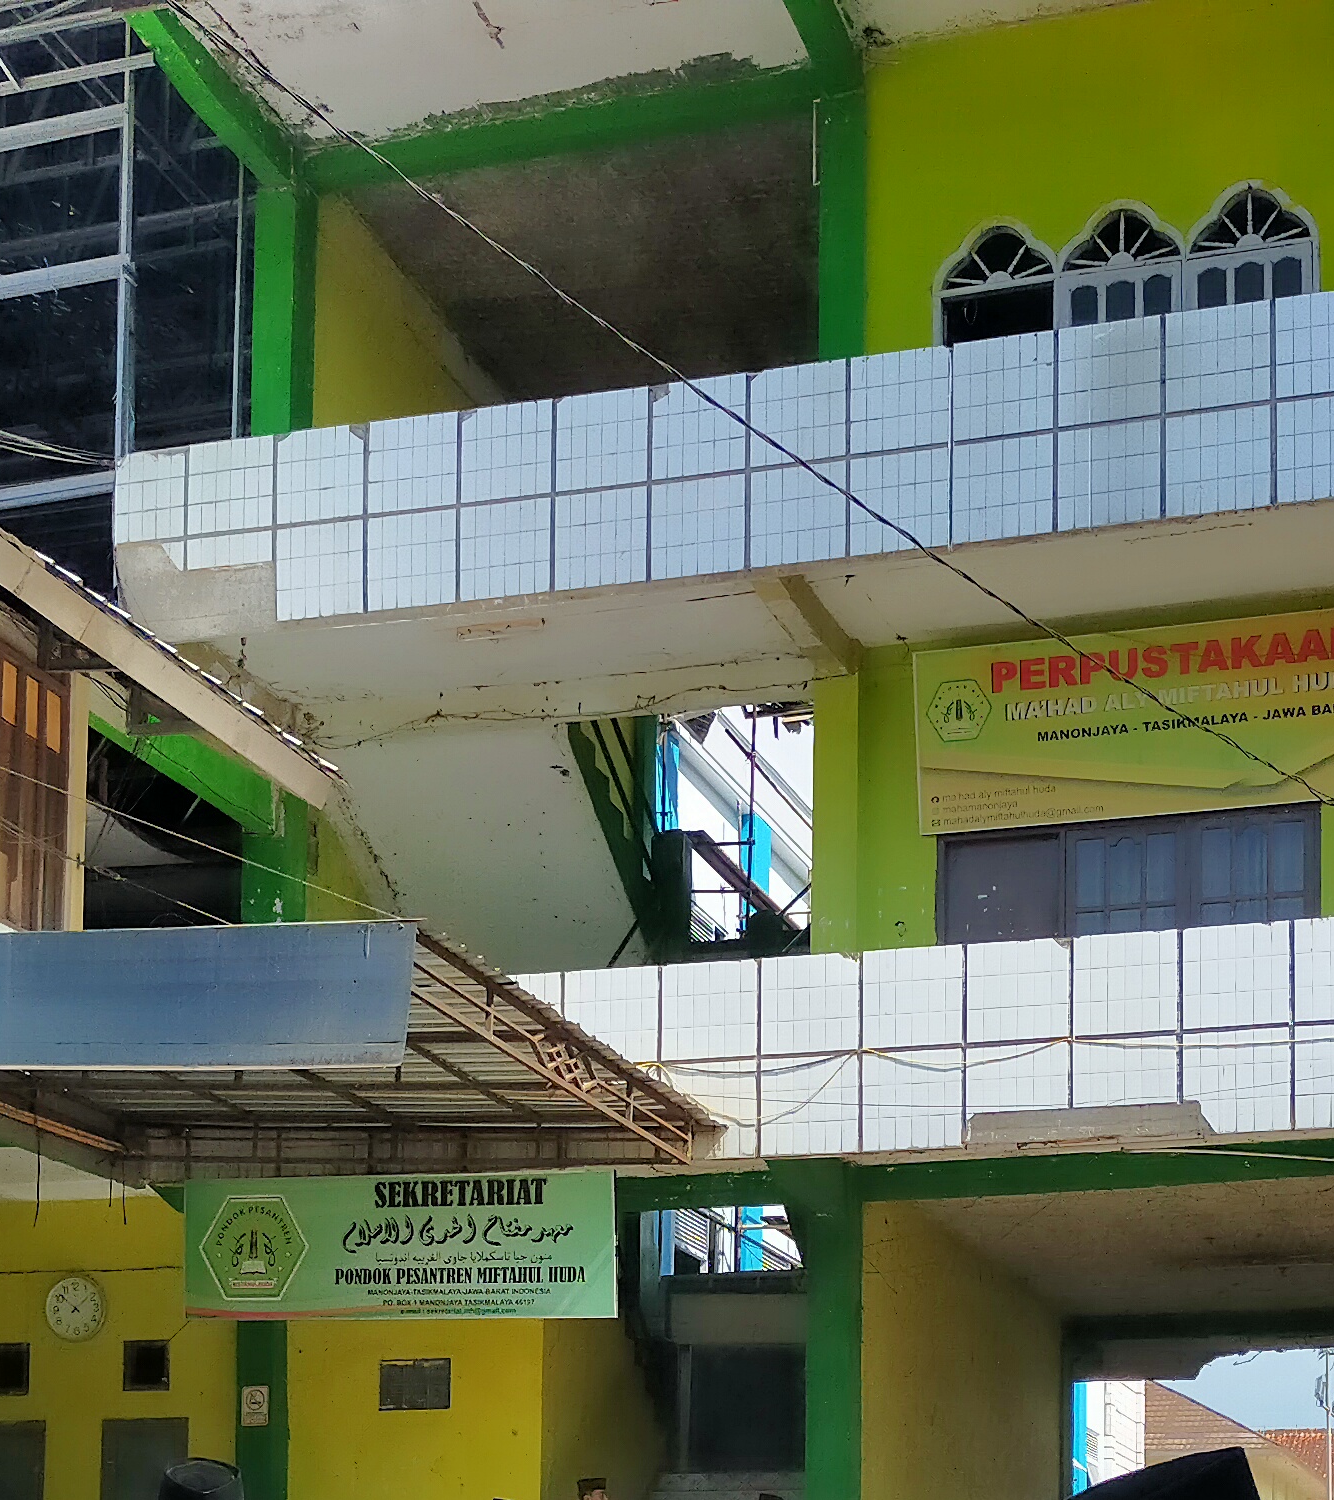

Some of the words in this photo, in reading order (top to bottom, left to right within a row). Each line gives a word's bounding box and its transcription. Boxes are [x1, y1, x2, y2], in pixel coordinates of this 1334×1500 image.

[1005, 696, 1097, 721] MA'HAD
[1104, 690, 1147, 712] ALY
[1158, 677, 1284, 706] MIFTAHUL
[1037, 724, 1129, 742] MANONJAYA
[1142, 712, 1249, 732] TASIKMALAYA
[1262, 706, 1306, 721] JAWA
[374, 1178, 547, 1209] SEKRETARIAT
[216, 1208, 246, 1247] PONDOK
[334, 1267, 391, 1285] PONDOK
[395, 1267, 472, 1285] PESANTREN
[476, 1266, 544, 1284] MIFTAHUL
[548, 1265, 586, 1283] HUDA
